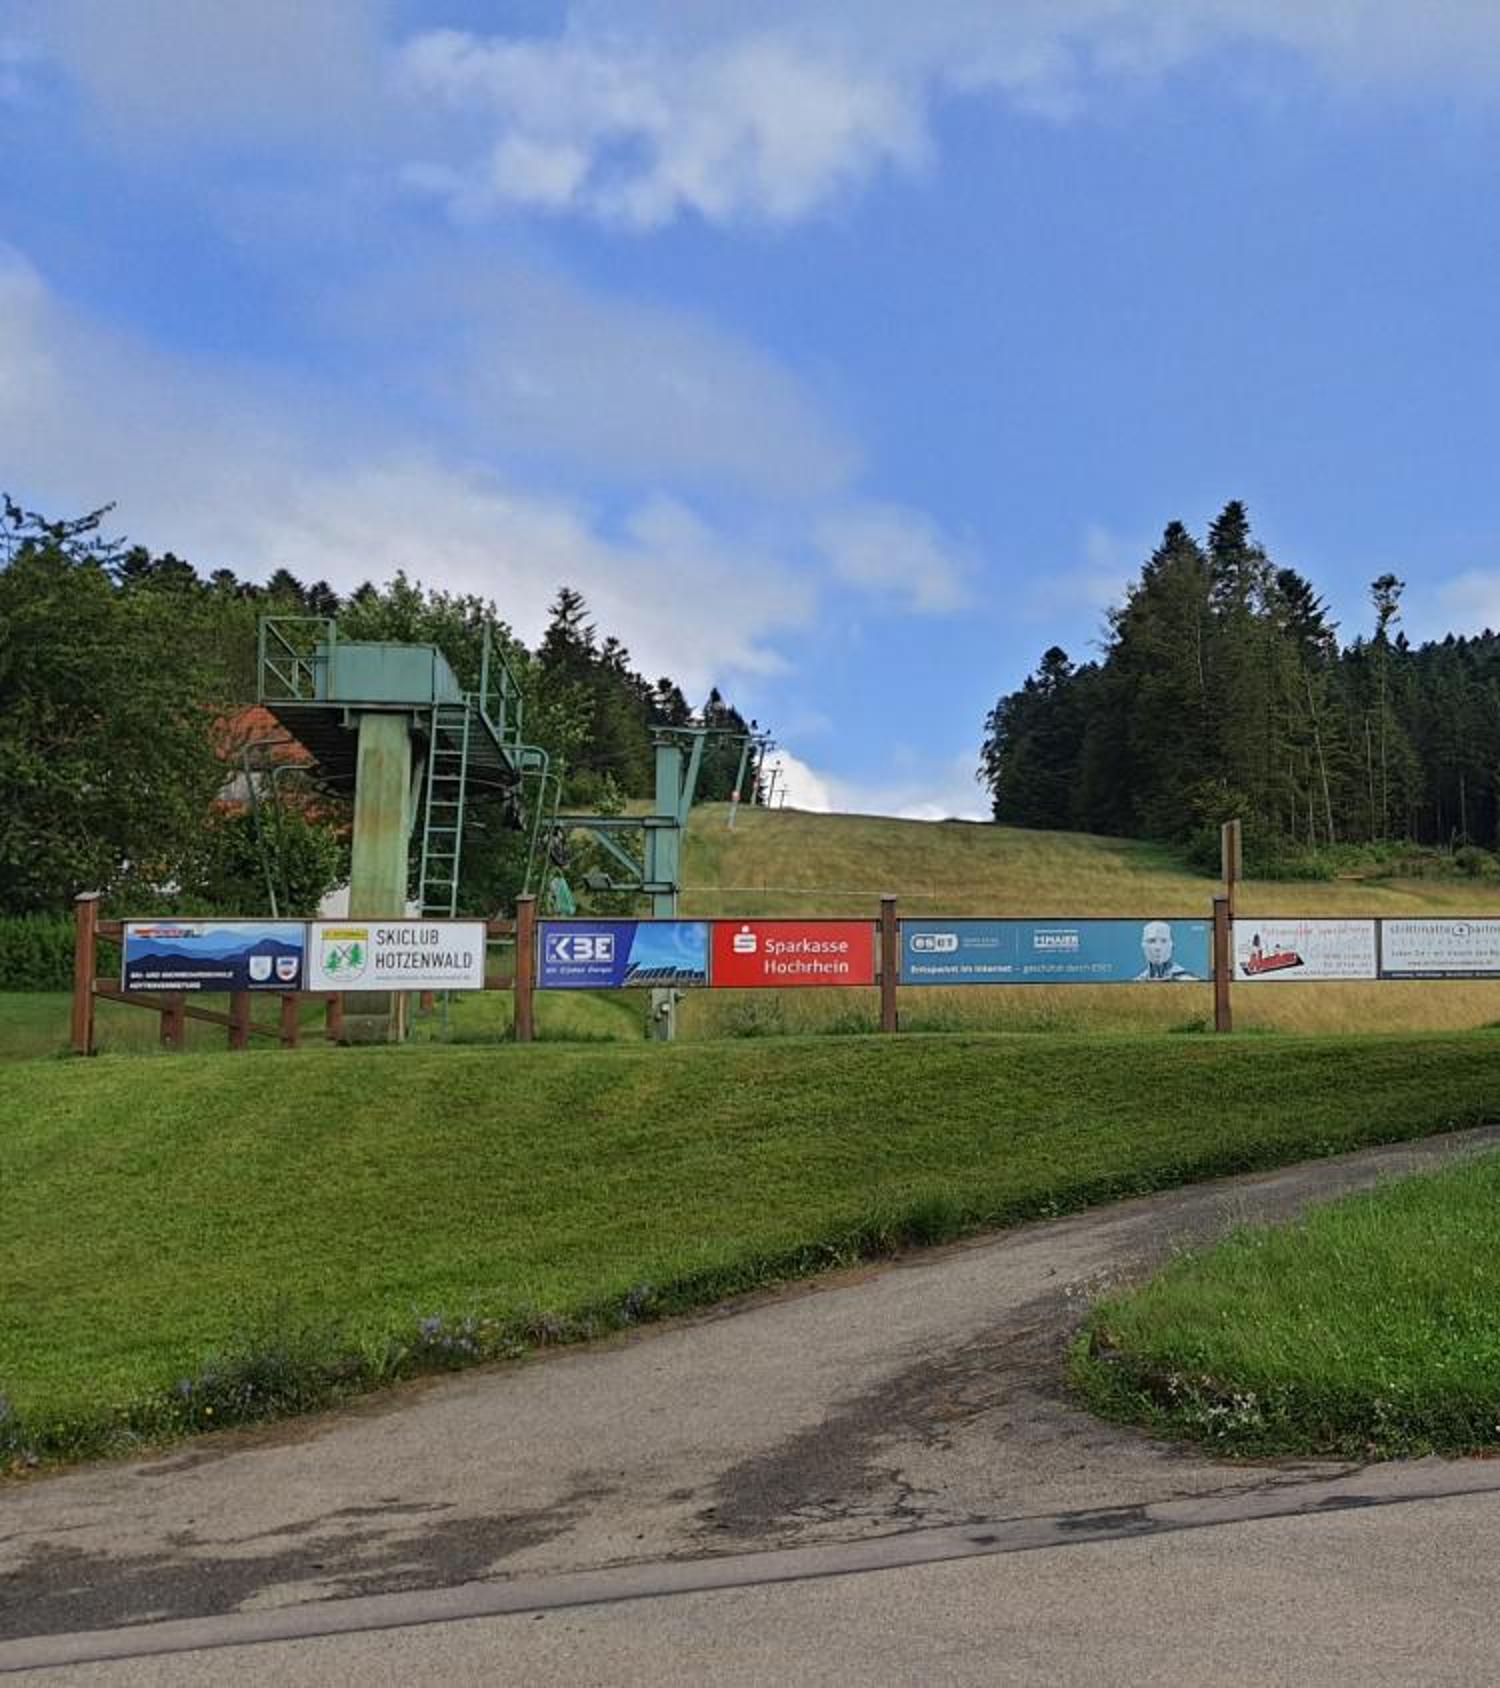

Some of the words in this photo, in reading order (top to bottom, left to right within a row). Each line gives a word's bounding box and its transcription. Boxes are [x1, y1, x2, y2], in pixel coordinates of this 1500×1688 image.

[375, 928, 440, 946] SKICLUB
[764, 938, 849, 955] Sparkasse
[375, 951, 473, 969] HOTZENWALD
[764, 959, 849, 974] Hochrhein
